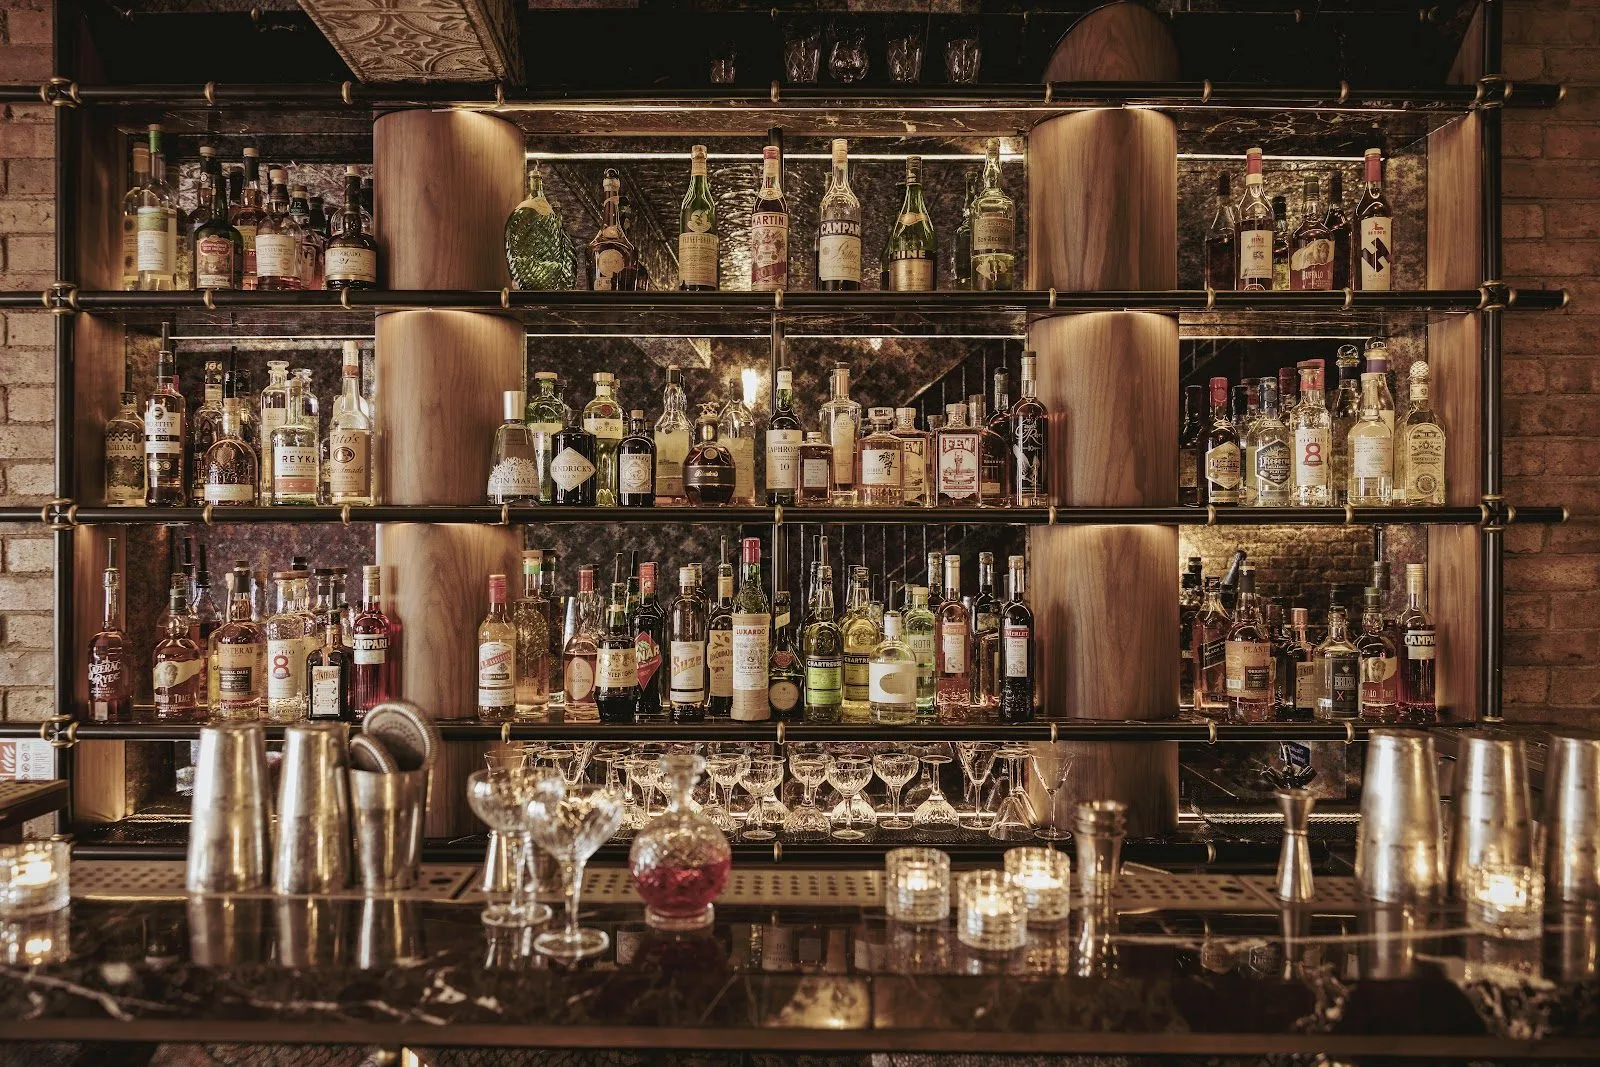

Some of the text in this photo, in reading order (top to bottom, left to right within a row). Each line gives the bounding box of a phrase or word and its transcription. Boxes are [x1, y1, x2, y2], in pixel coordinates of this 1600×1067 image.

[893, 250, 926, 259] HINE
[332, 434, 360, 444] Tito's
[946, 438, 972, 449] FEW
[282, 455, 316, 463] REYKA
[1305, 443, 1322, 467] 8
[780, 463, 790, 471] 10
[273, 655, 291, 679] 8
[1337, 691, 1345, 701] X
